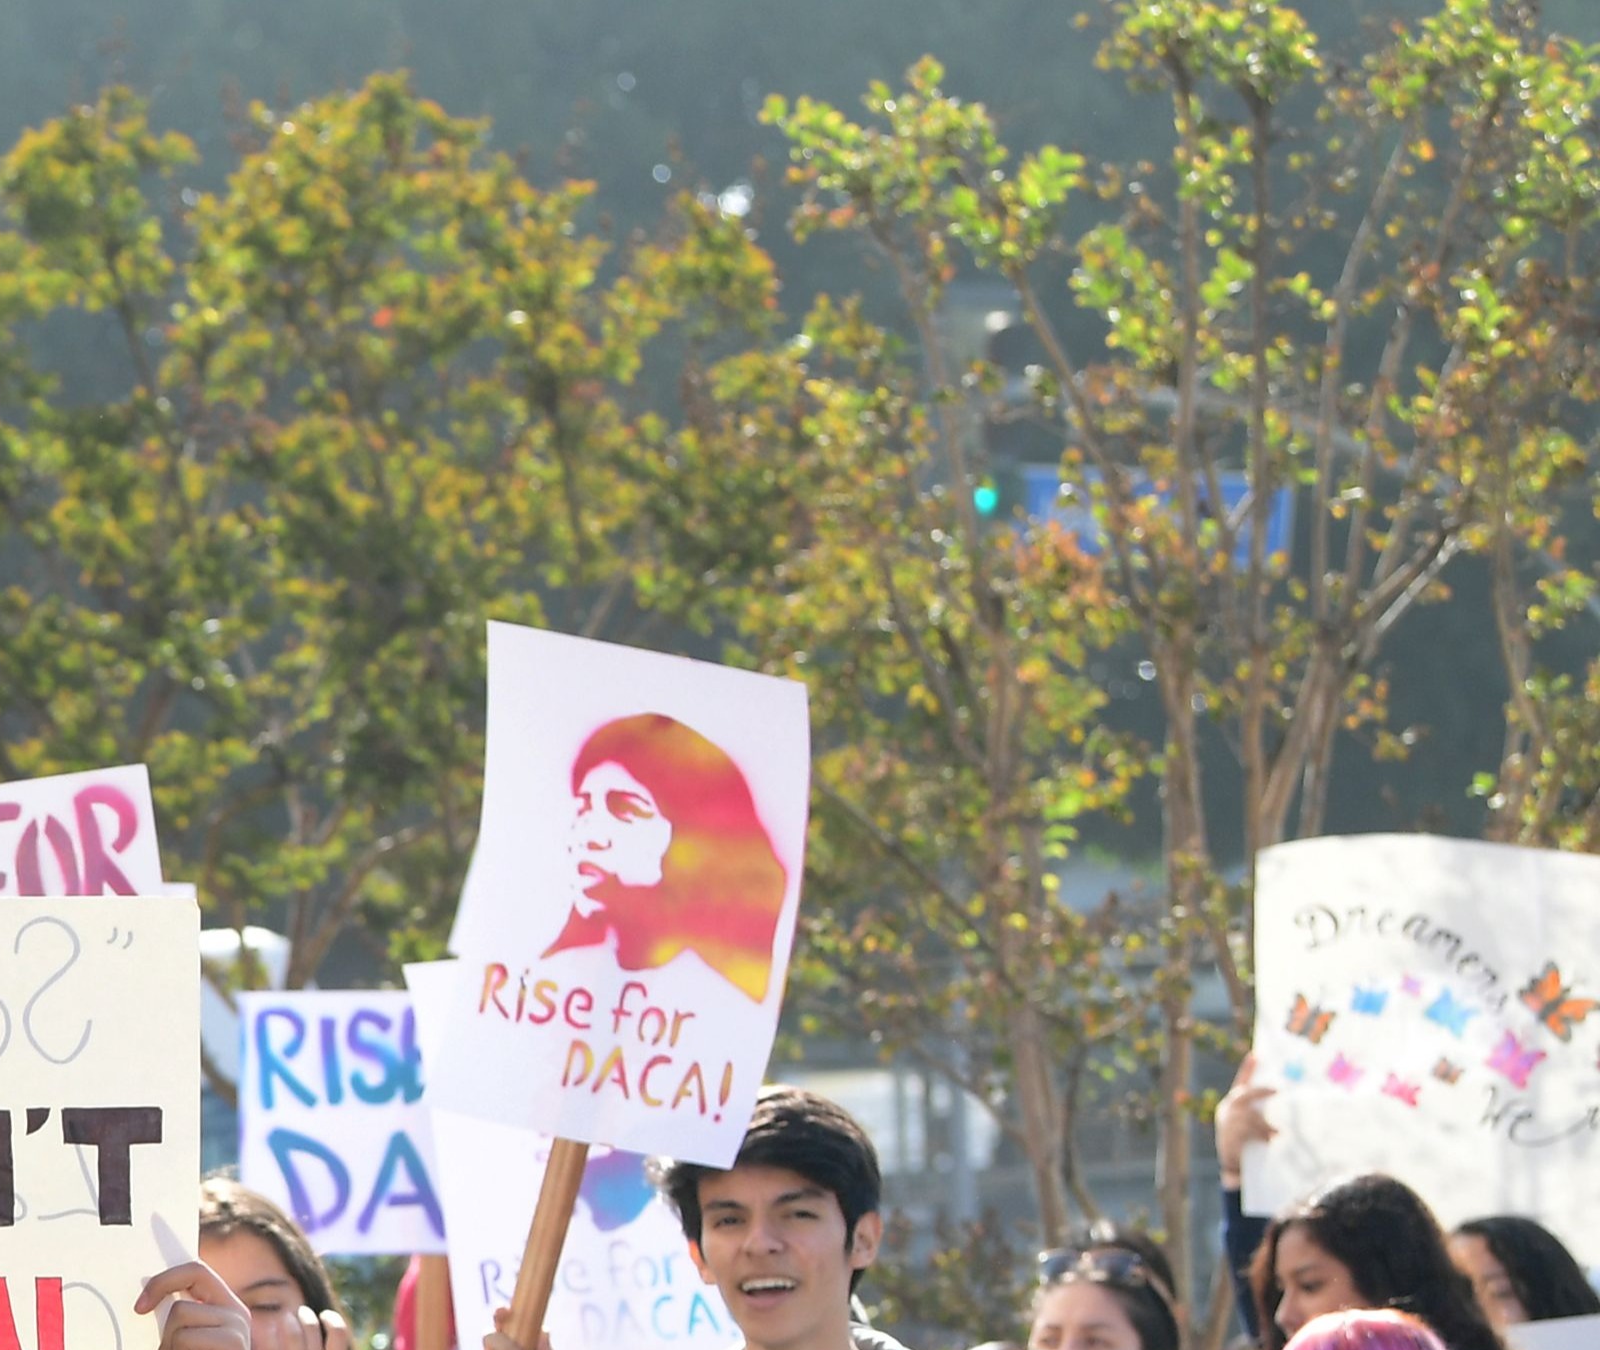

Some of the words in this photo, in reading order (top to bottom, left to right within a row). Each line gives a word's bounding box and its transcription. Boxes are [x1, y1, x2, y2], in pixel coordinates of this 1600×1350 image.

[478, 962, 594, 1031] Rise
[611, 980, 696, 1049] for
[562, 1042, 735, 1124] DACA!
[268, 1129, 446, 1236] DA
